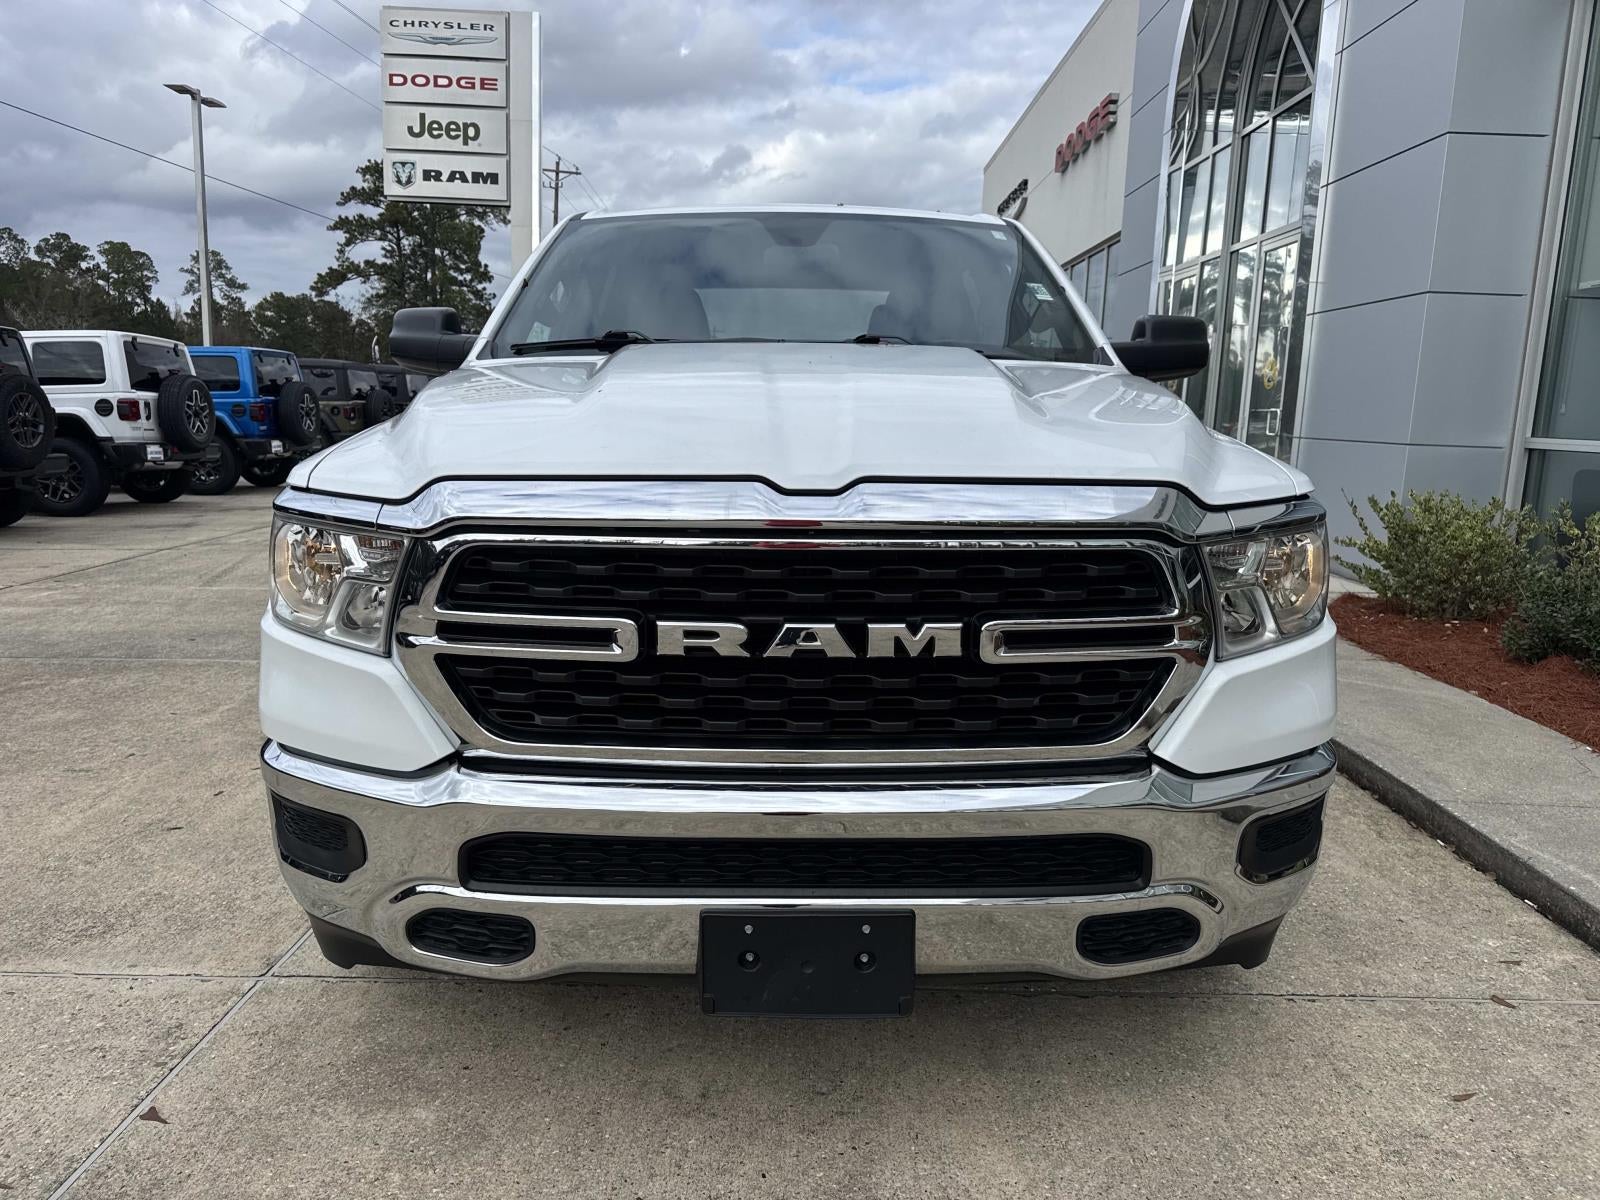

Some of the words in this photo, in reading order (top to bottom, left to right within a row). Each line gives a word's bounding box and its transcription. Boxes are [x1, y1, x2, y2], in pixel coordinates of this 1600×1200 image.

[388, 19, 495, 32] CHRYSLER
[388, 73, 499, 91] DODGE
[407, 112, 481, 146] Jeep
[1054, 92, 1120, 173] DODGE
[422, 169, 499, 185] RAM
[656, 620, 963, 658] RAM
